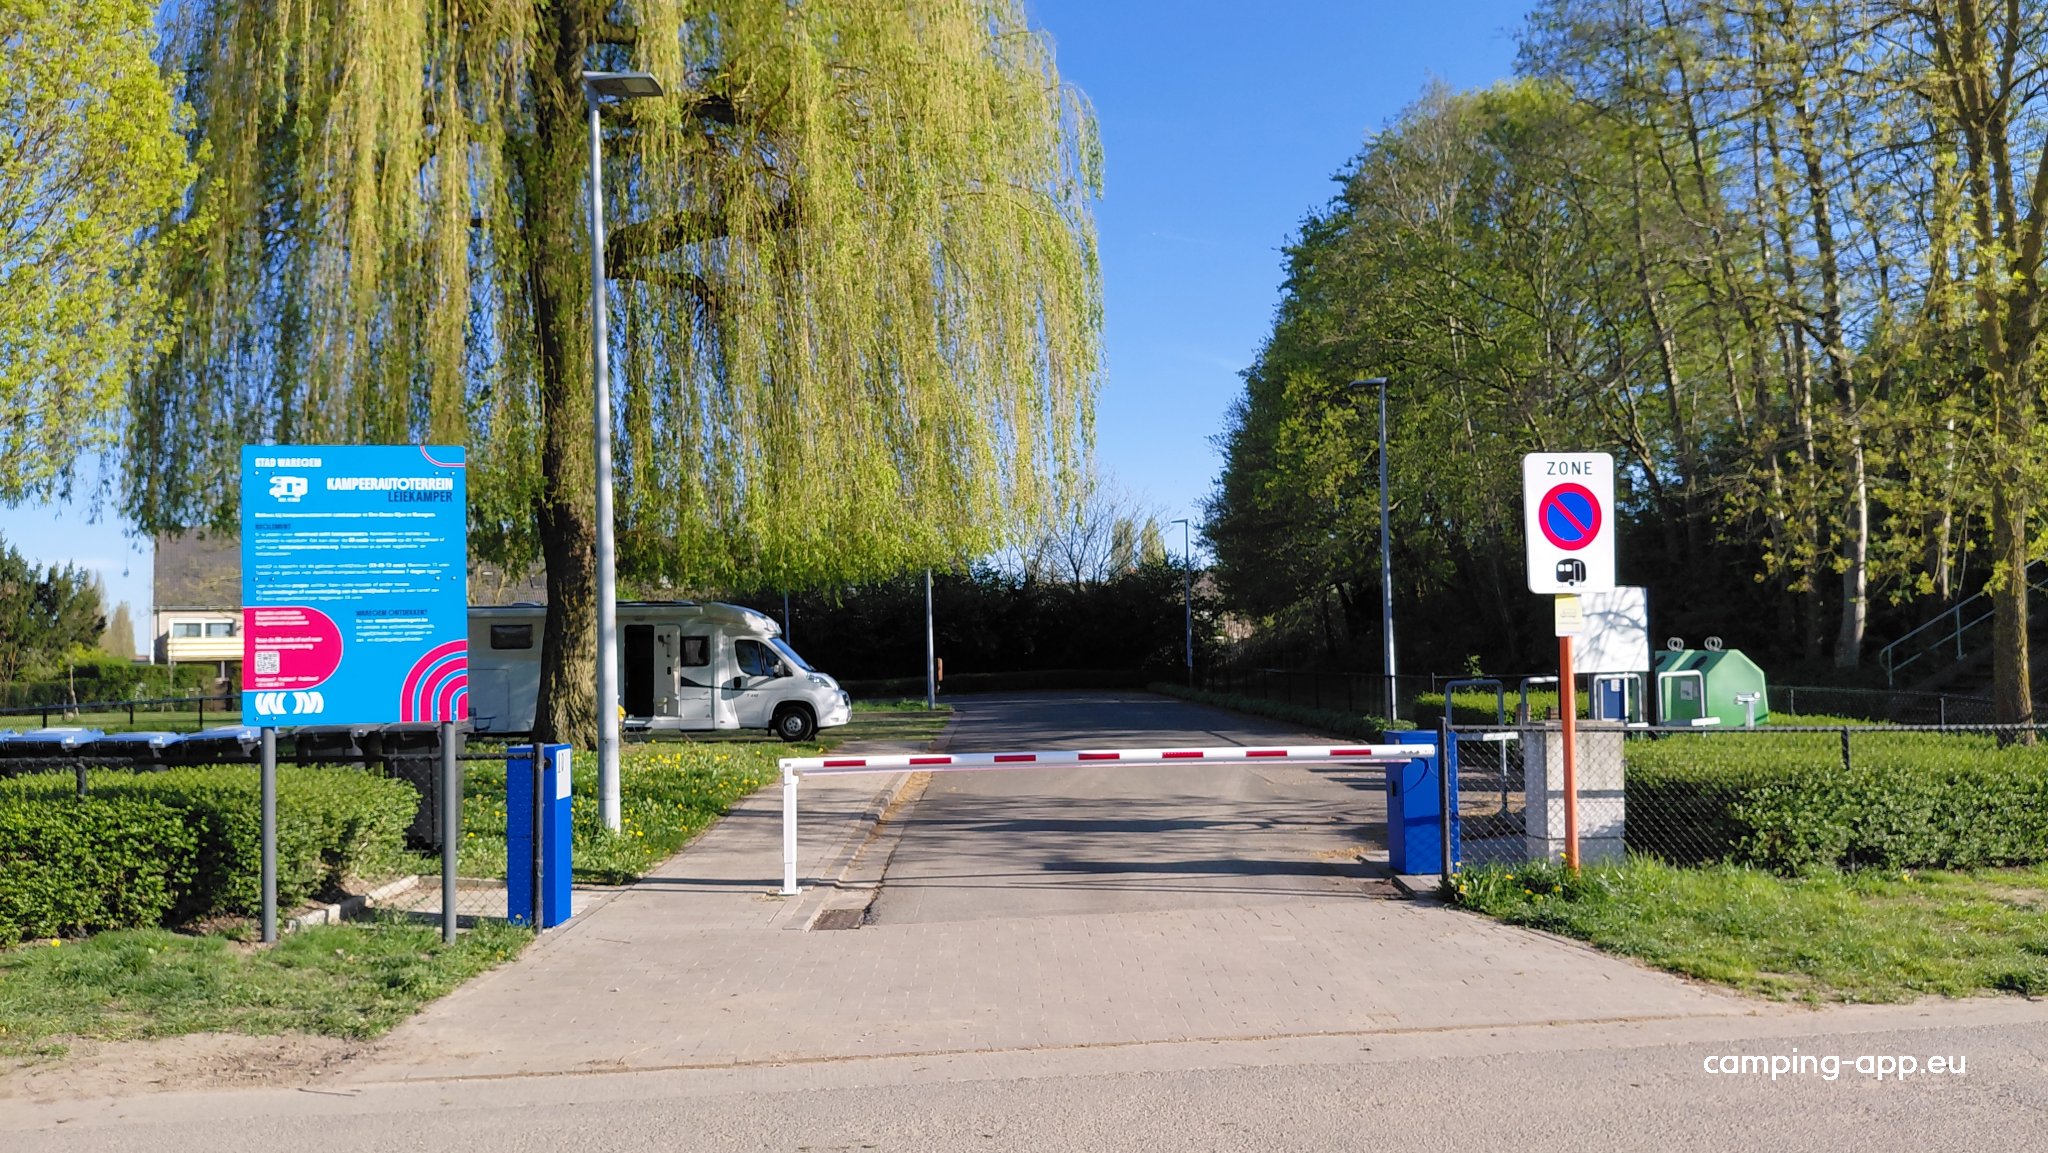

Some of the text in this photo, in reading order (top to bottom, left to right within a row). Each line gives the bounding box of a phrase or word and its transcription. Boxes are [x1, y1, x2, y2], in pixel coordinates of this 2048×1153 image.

[255, 457, 322, 468] STAD WAREGEM
[1546, 461, 1593, 476] ZONE
[326, 477, 454, 491] KAMPEERAUTOTERREIN
[387, 491, 454, 503] LEIEKAMPER
